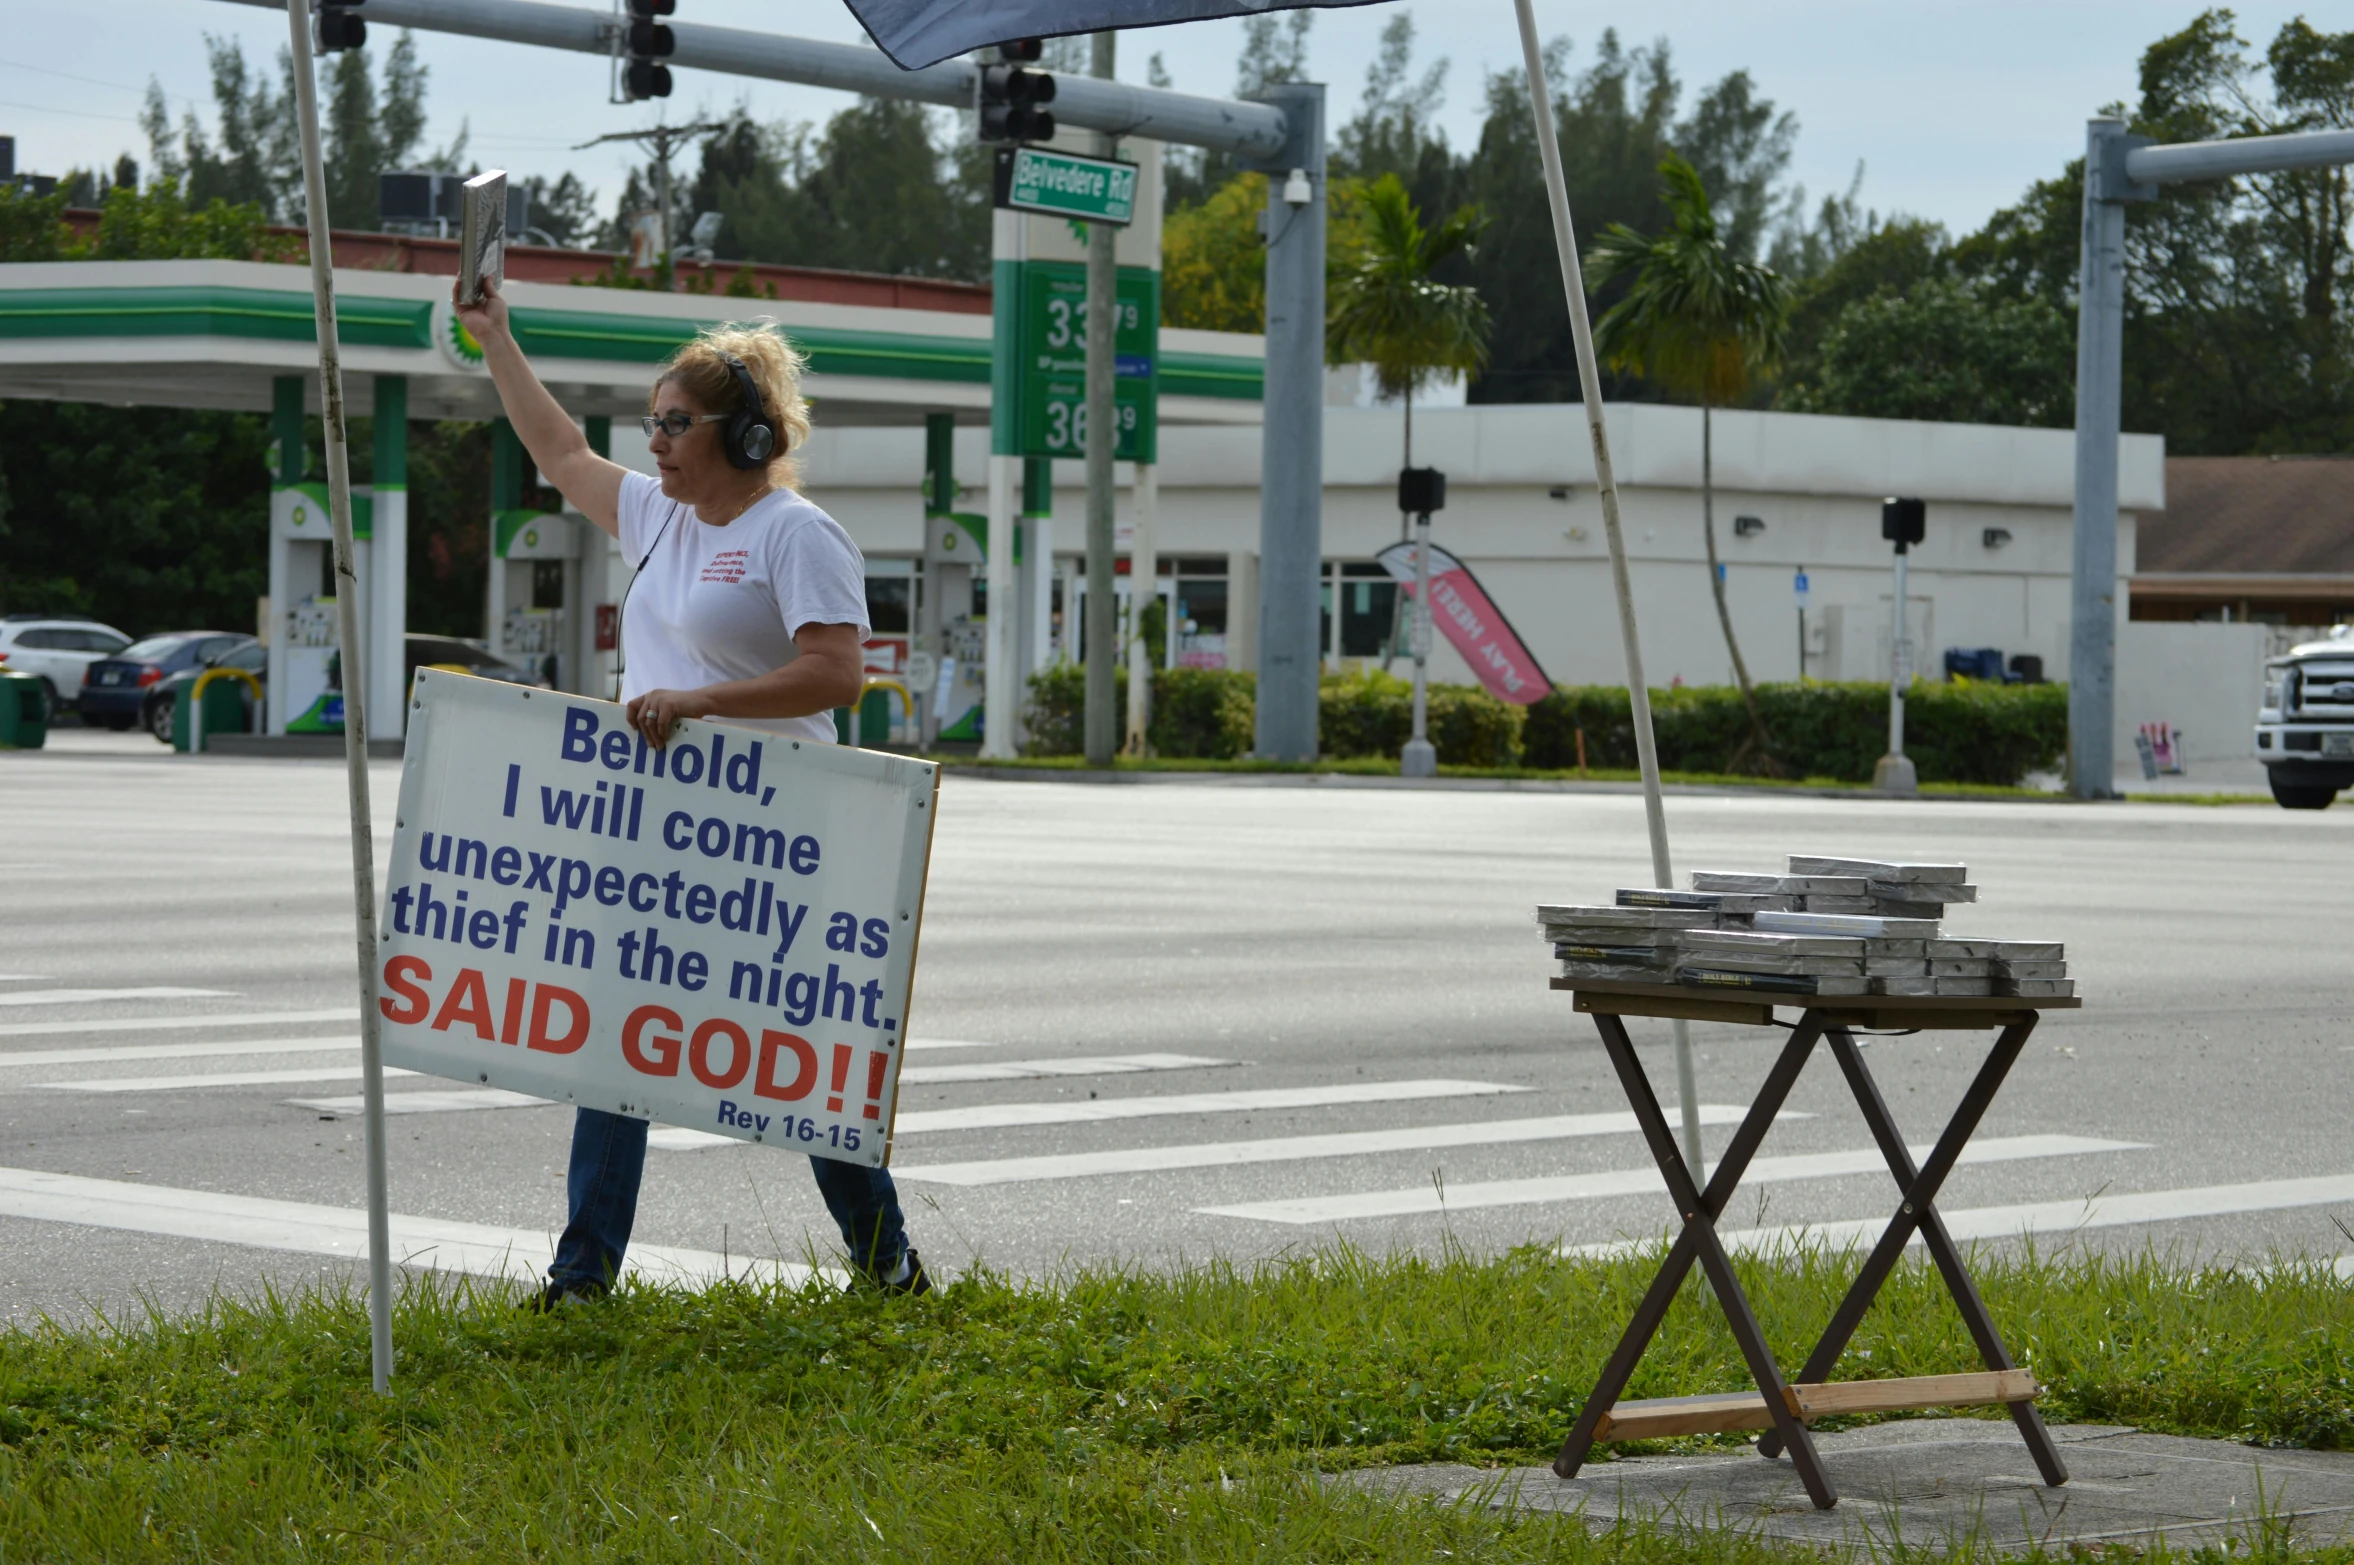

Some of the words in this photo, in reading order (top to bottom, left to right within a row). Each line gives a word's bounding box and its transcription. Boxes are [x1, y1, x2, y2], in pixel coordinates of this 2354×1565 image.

[1018, 155, 1105, 198] Belvedere
[1107, 169, 1134, 202] Rd
[1431, 578, 1485, 641] HERE!
[1481, 644, 1524, 693] PLAY
[560, 706, 777, 806] Behold,
[502, 764, 521, 818] I
[540, 780, 645, 841] will
[662, 811, 821, 876] come
[419, 832, 809, 955] unexpectedly
[826, 911, 890, 959] as
[390, 883, 530, 955] thief
[544, 909, 596, 970] in
[617, 927, 709, 992] the
[729, 953, 897, 1031] night.
[379, 955, 592, 1055] SAID
[620, 1005, 890, 1121] GOD!!
[717, 1100, 771, 1133] Rev
[782, 1115, 862, 1152] 16-15
